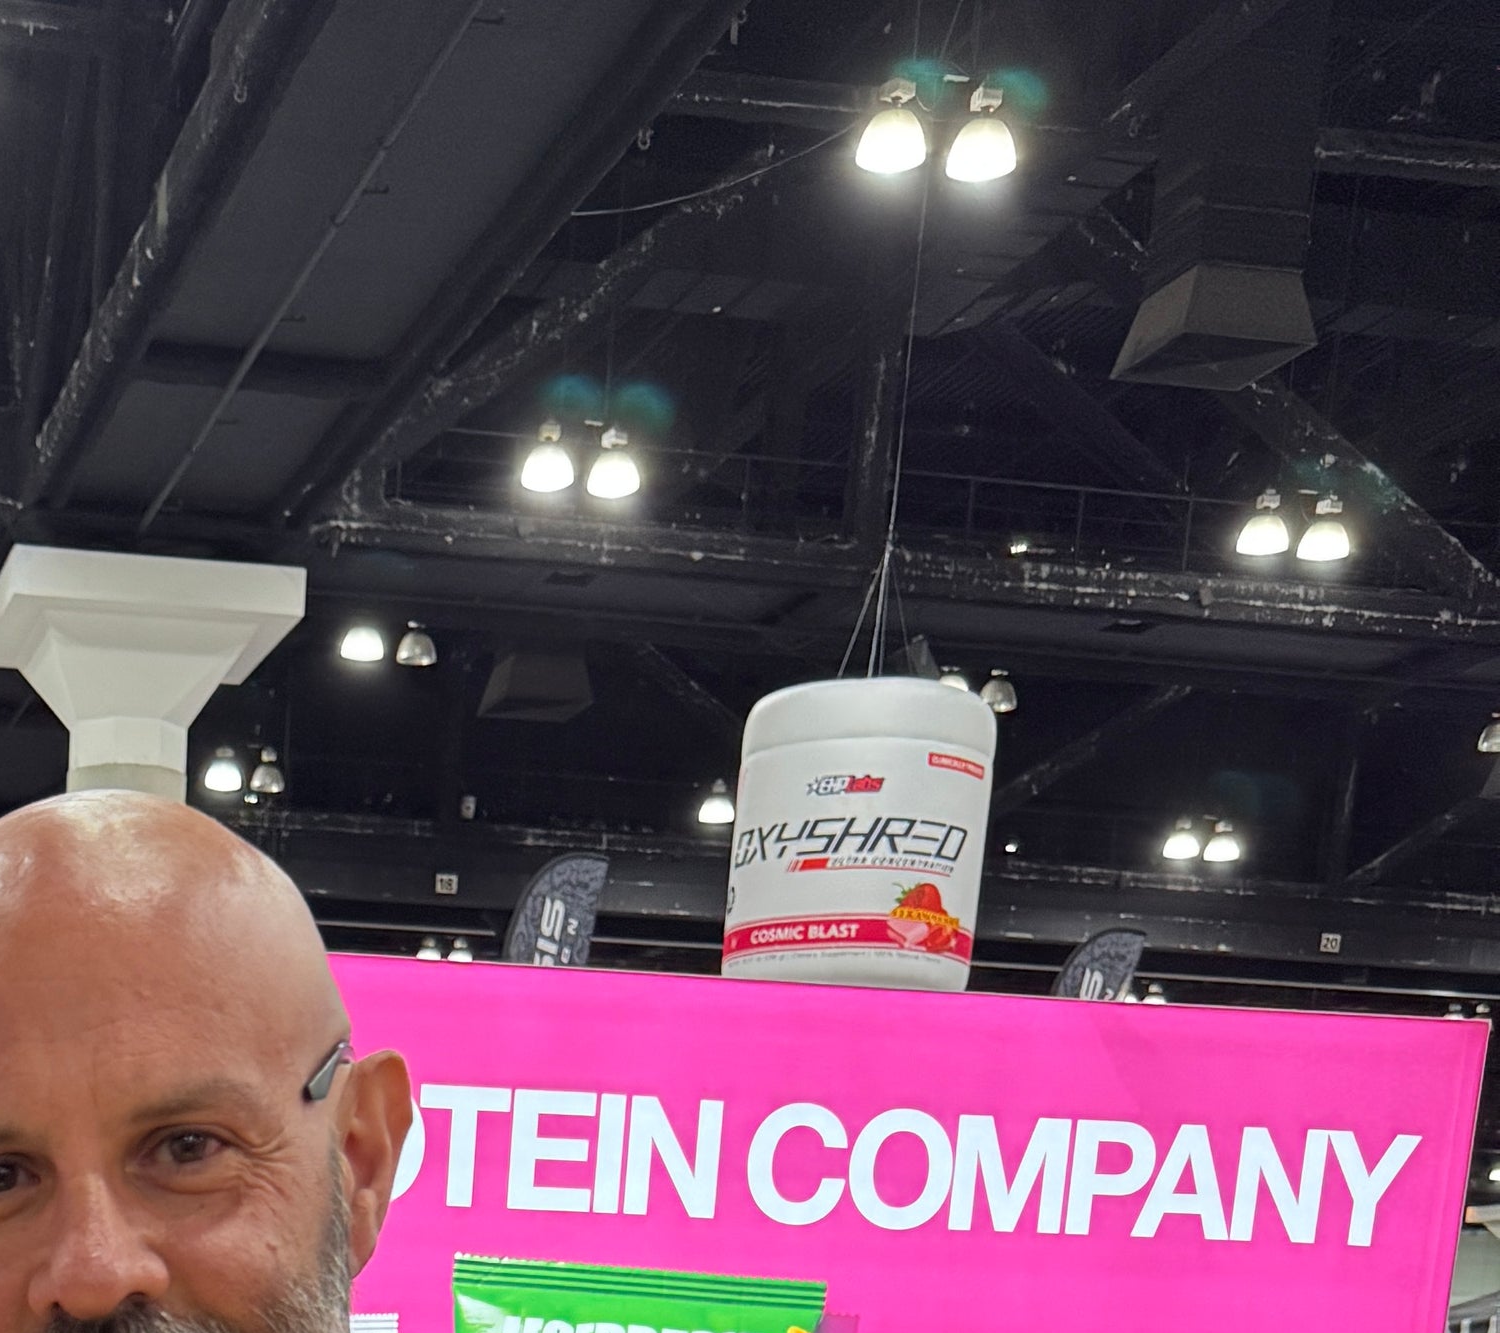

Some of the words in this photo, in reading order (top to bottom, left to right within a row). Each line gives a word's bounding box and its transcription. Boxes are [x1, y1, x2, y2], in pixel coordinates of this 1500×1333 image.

[735, 817, 968, 869] OXYSHRED
[750, 923, 805, 945] COSMIC
[807, 922, 860, 940] BLAST
[1323, 937, 1338, 950] 20
[747, 1101, 1422, 1246] COMPANY
